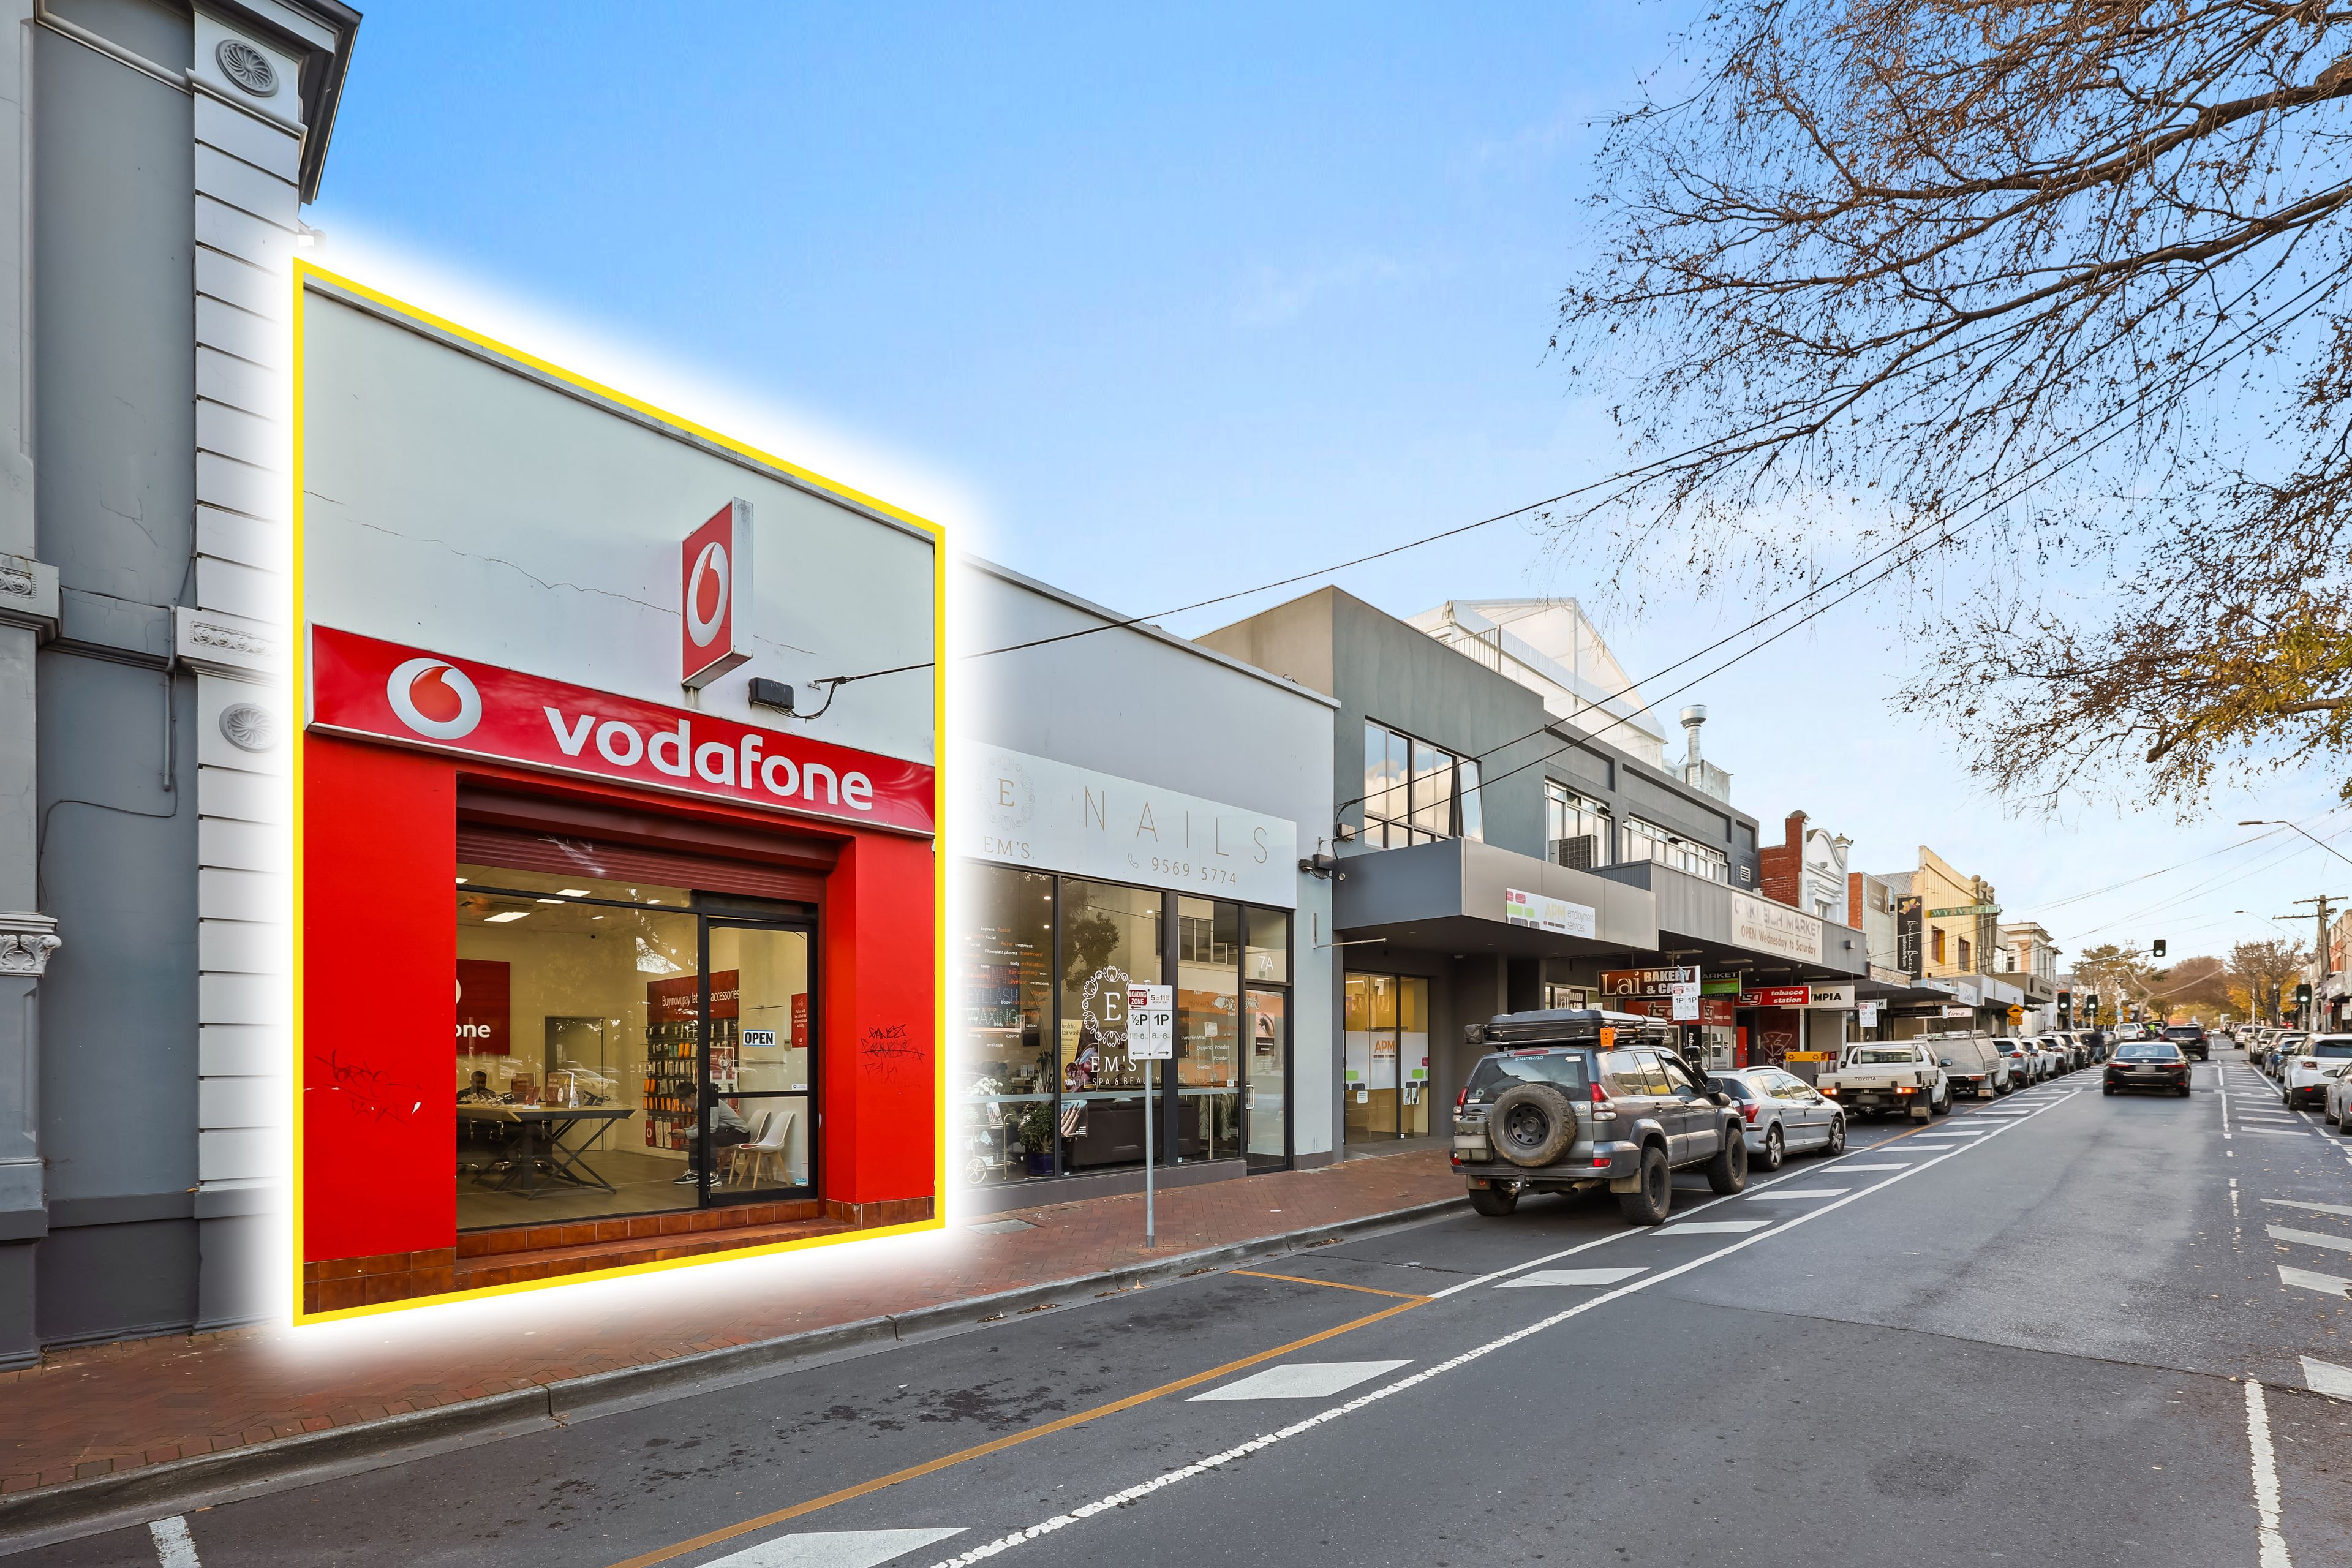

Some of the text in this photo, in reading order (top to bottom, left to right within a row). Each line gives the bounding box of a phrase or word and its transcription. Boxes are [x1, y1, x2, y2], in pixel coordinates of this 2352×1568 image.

[543, 706, 872, 810] vodafone
[998, 778, 1015, 807] E
[1085, 785, 1268, 864] NAILS
[981, 836, 1030, 859] EM'S
[1152, 857, 1237, 886] 9569 5774
[1545, 902, 1566, 922] APM
[1567, 910, 1594, 922] employment
[1567, 922, 1585, 932] services
[1741, 925, 1816, 957] OPEN Wednesday to Saturday
[1259, 957, 1274, 971] 7A
[1602, 971, 1642, 995] Lai
[1647, 983, 1673, 994] & CA
[662, 996, 671, 1009] Buy
[682, 995, 692, 1007] pay
[710, 988, 739, 1002] accessories
[1569, 992, 1583, 1001] BAKERY
[1104, 992, 1122, 1022] E
[1154, 1014, 1169, 1025] 1P
[456, 1024, 491, 1038] ne
[745, 1032, 773, 1044] OPEN
[1374, 1040, 1395, 1054] APM
[1090, 1056, 1137, 1072] EM'S
[1064, 1078, 1086, 1087] NAIL
[1124, 1076, 1160, 1085] BEAUY
